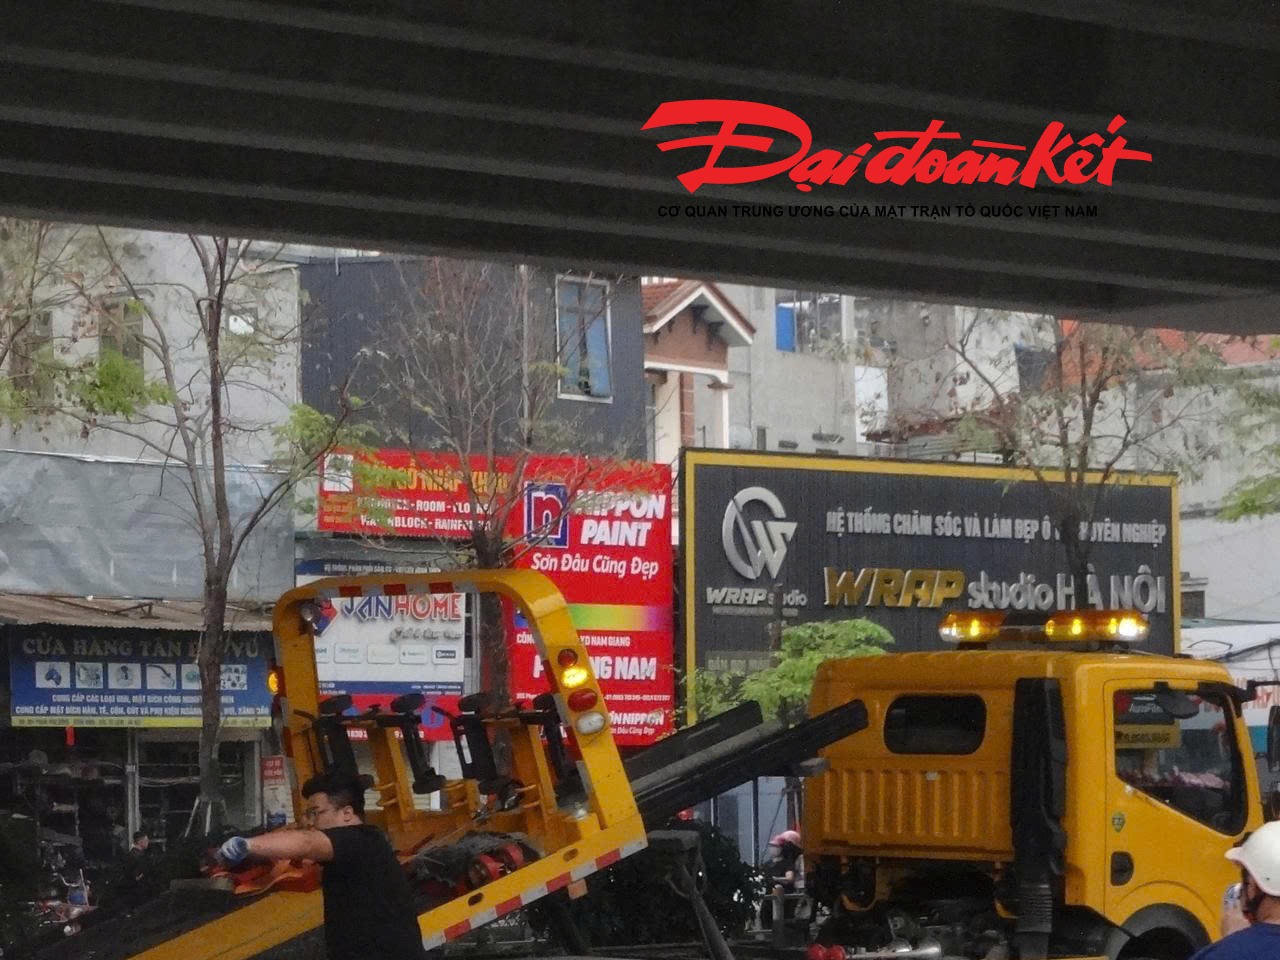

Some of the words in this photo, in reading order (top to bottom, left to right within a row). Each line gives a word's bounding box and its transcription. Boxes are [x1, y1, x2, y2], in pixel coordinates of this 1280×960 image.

[580, 519, 653, 547] PAINT
[826, 506, 846, 538] HỆ
[846, 506, 892, 535] THỐNG
[935, 511, 963, 537] SÓC
[963, 512, 982, 538] VÀ
[531, 553, 559, 571] Sơn
[561, 553, 590, 572] Đâu
[592, 555, 627, 580] Cũng
[631, 557, 659, 580] Đẹp
[706, 587, 768, 605] WRAP
[823, 566, 966, 608] WRAP
[967, 570, 1055, 610] studio
[591, 636, 608, 647] NAM
[608, 637, 631, 647] GIANG
[615, 657, 658, 681] NAM
